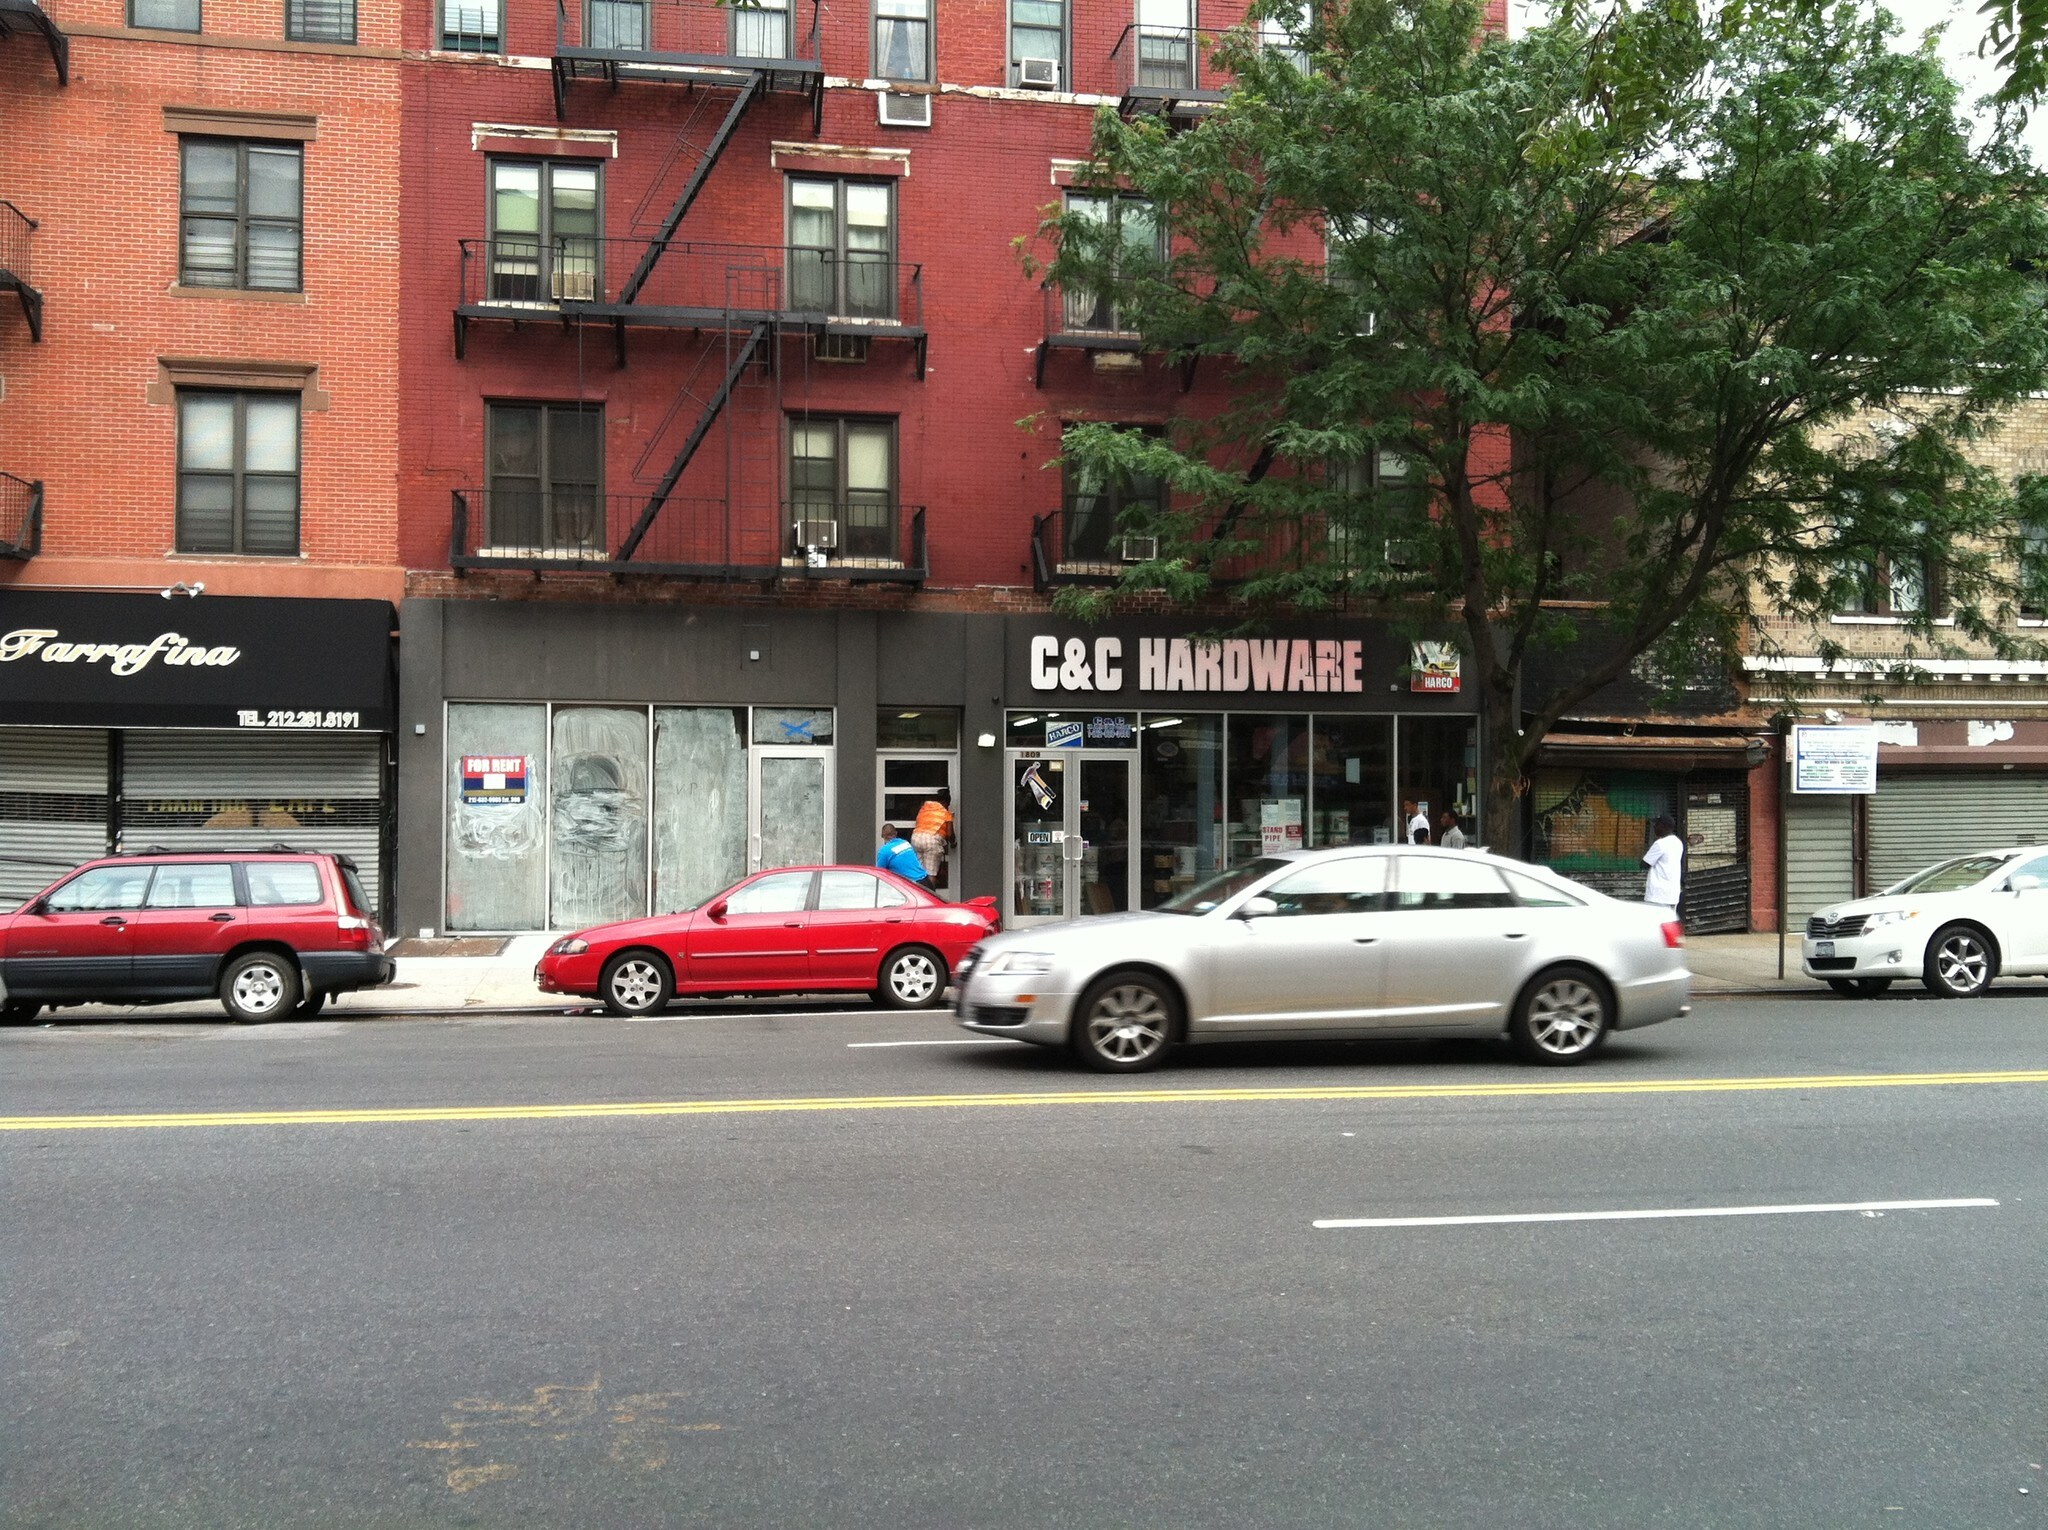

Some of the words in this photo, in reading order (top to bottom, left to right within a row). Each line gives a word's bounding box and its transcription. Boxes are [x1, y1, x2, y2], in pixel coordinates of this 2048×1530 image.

[1030, 635, 1123, 691] C&C
[1139, 637, 1363, 692] HARDWARE
[1425, 677, 1453, 688] HARCO
[237, 710, 266, 727] TEL.
[267, 711, 359, 728] 212.281.8191
[1049, 723, 1080, 741] HARCO
[467, 758, 490, 773] FOR
[491, 758, 522, 773] RENT
[1029, 832, 1049, 842] OPEN
